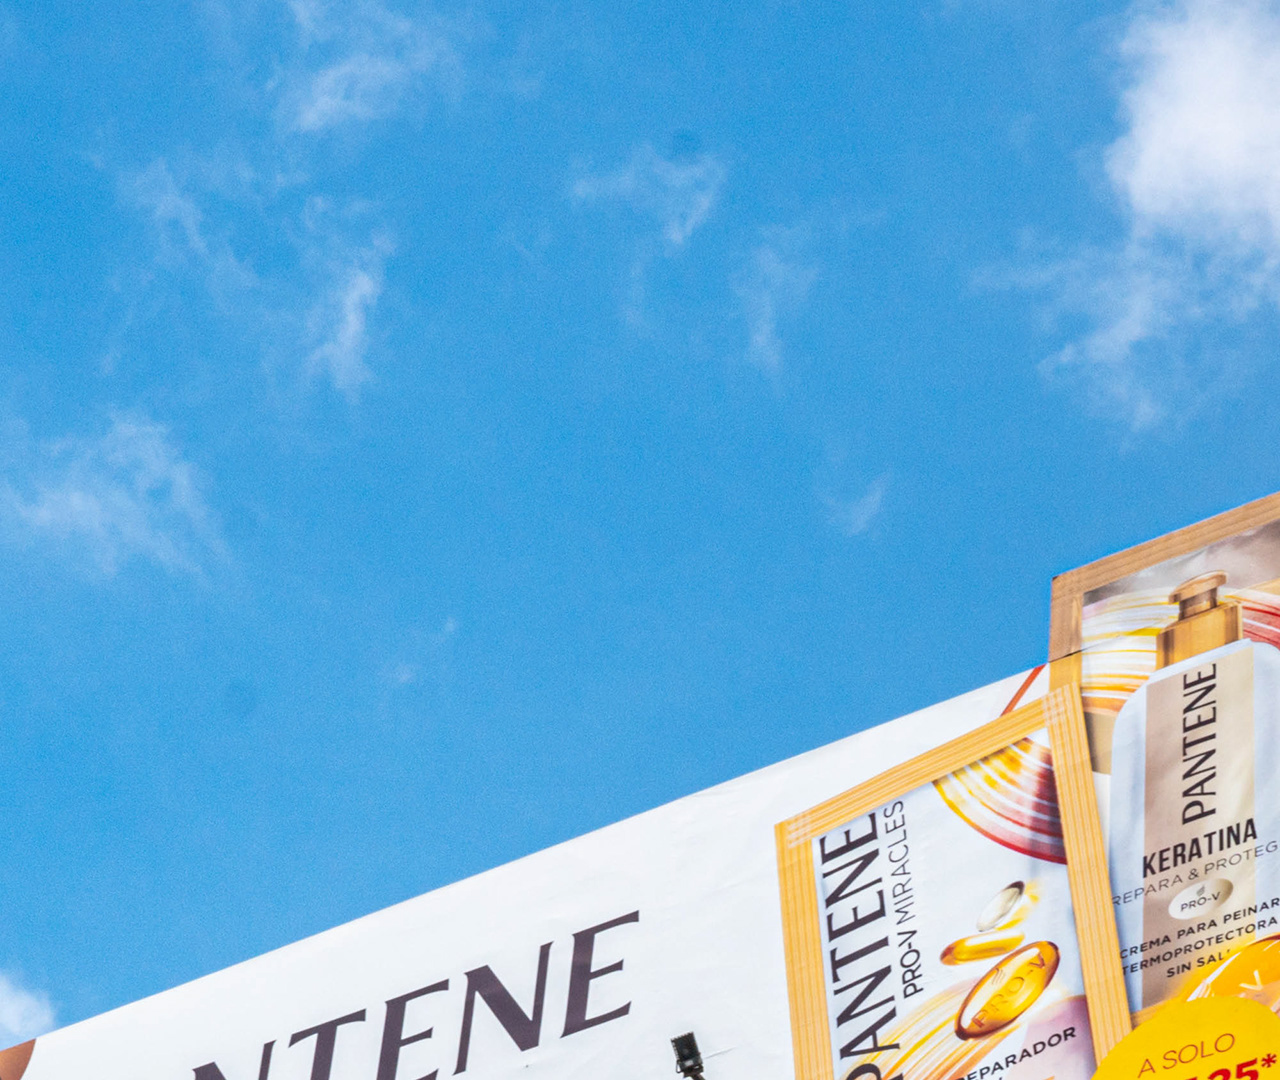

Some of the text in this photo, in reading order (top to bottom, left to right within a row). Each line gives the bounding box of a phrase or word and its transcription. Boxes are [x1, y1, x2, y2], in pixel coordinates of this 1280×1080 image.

[1182, 662, 1217, 826] PANTENE
[1142, 817, 1258, 879] KERATINA
[884, 800, 924, 999] PRO-V MIRACLES
[1112, 873, 1184, 907] REPARA
[1188, 867, 1200, 880] &
[1180, 890, 1222, 912] PRO-V
[1120, 897, 1280, 959] CREMA PARA PEINAR
[1122, 916, 1278, 976] TERMOPROTECTORA
[1166, 961, 1191, 978] SIN
[1137, 1033, 1236, 1078] A SOLO
